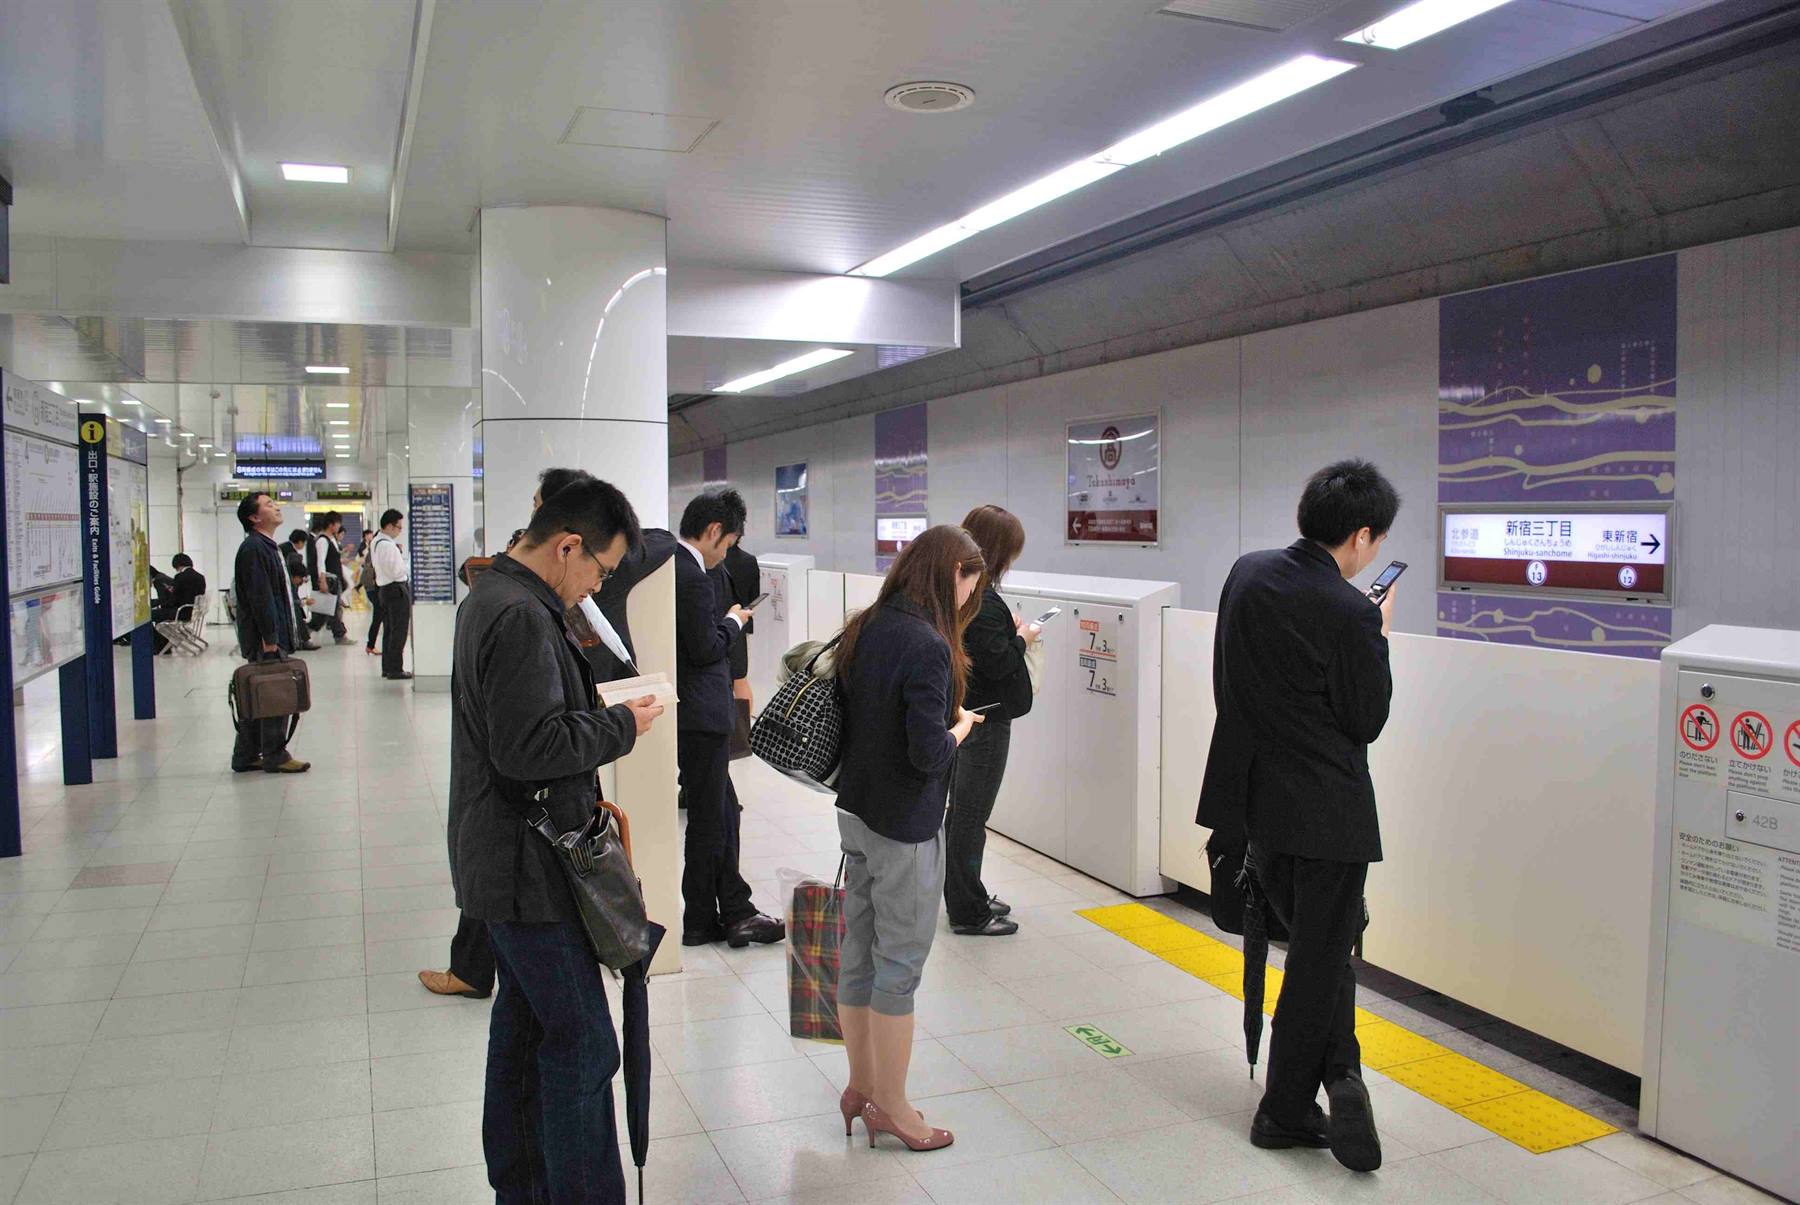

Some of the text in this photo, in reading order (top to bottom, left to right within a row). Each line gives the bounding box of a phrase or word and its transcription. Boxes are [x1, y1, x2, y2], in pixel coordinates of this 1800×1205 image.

[1087, 474, 1136, 490] Takashimaya
[87, 450, 100, 536] 出口・駅施設のご案内
[1506, 520, 1571, 537] 新宿三丁目
[1602, 529, 1638, 544] 東新宿
[1503, 547, 1573, 558] Shinjuku-sanchome
[1532, 572, 1543, 582] 13
[1623, 576, 1633, 584] 12
[1090, 632, 1108, 653] 7 3
[1089, 670, 1108, 691] 7 3
[1728, 759, 1771, 773] 立てかけない
[1752, 814, 1778, 830] 42B
[1679, 831, 1740, 853] 安全のためのお願い
